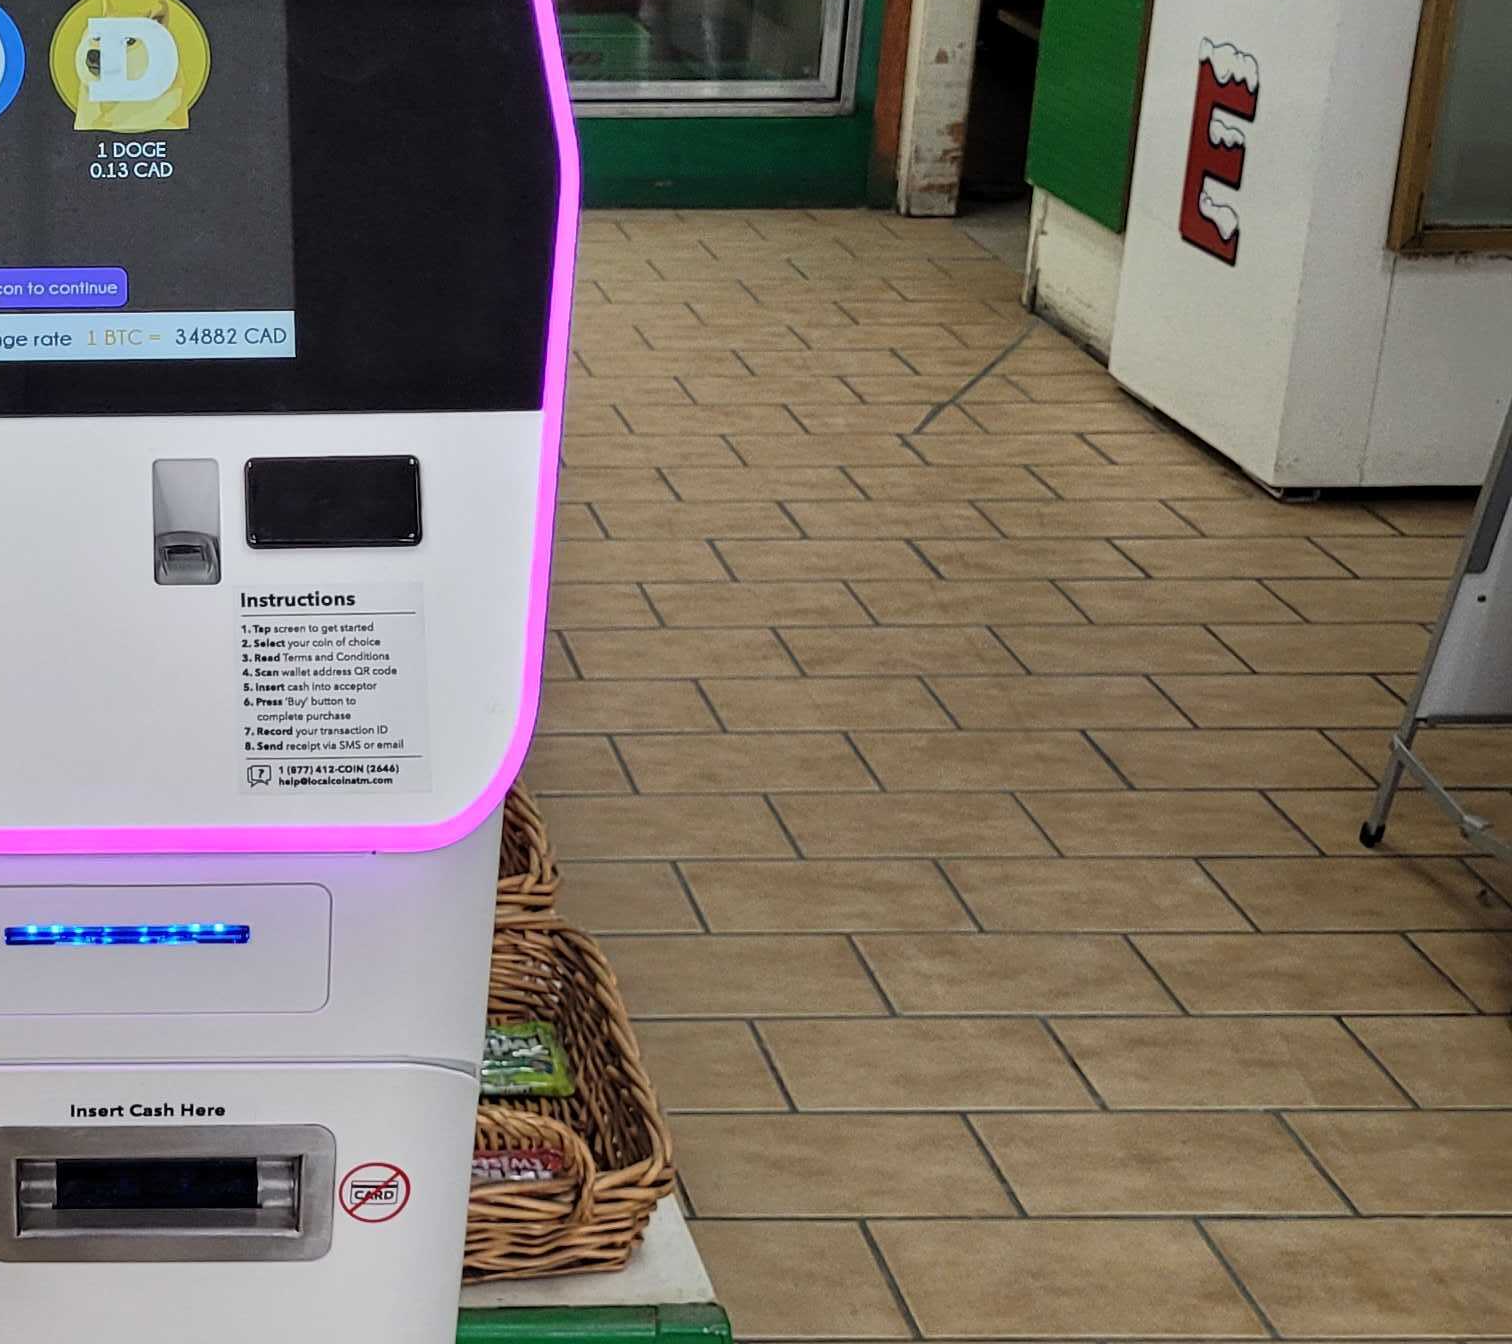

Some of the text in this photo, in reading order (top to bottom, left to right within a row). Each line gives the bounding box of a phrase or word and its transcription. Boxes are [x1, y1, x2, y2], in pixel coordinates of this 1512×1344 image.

[97, 141, 167, 158] 1 DOGE
[90, 161, 173, 179] 0.13 CAD
[27, 281, 45, 296] to
[48, 280, 118, 296] continue
[32, 331, 74, 348] rate
[87, 330, 97, 347] 1
[104, 329, 143, 346] BTC
[174, 328, 239, 346] 34882
[244, 328, 288, 345] CAD
[240, 590, 356, 608] Instructions
[252, 625, 271, 635] Tap
[70, 1103, 226, 1118] Insert Cash Here
[354, 1189, 394, 1201] CARD
